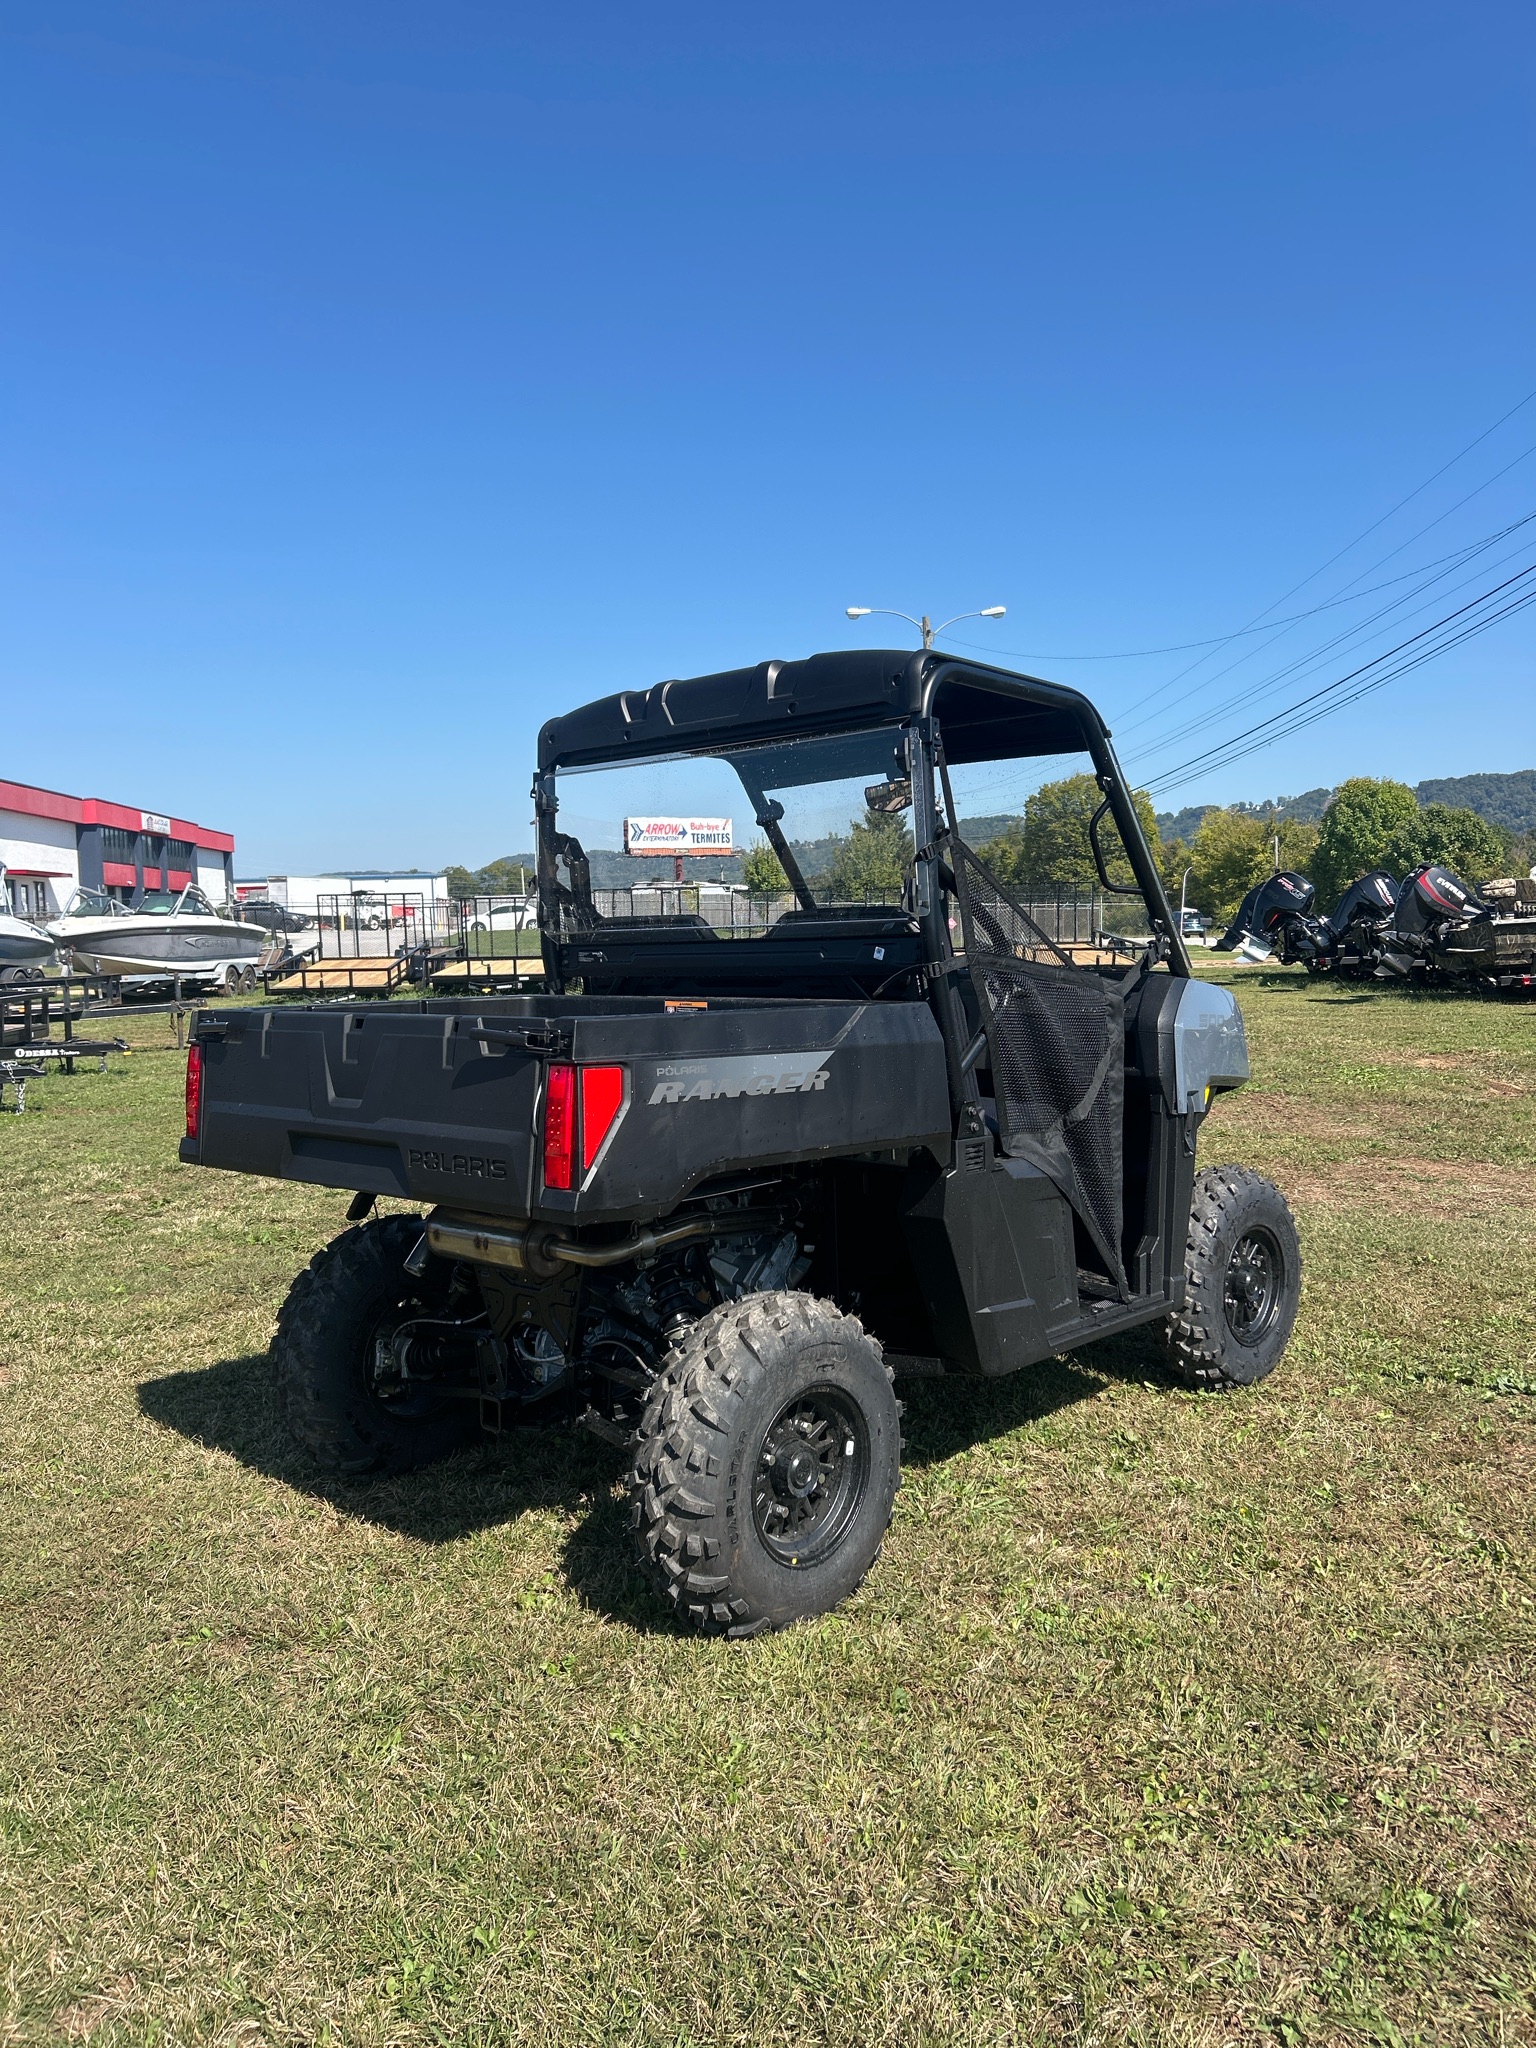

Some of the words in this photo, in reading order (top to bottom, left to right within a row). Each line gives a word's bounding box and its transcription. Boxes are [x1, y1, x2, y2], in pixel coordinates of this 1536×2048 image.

[644, 823, 681, 835] ARROW
[690, 833, 731, 844] TERMITES
[15, 1048, 60, 1058] ODESSA
[655, 1064, 709, 1077] POLARIS
[646, 1070, 831, 1106] RANGER
[407, 1149, 508, 1181] POLARIS
